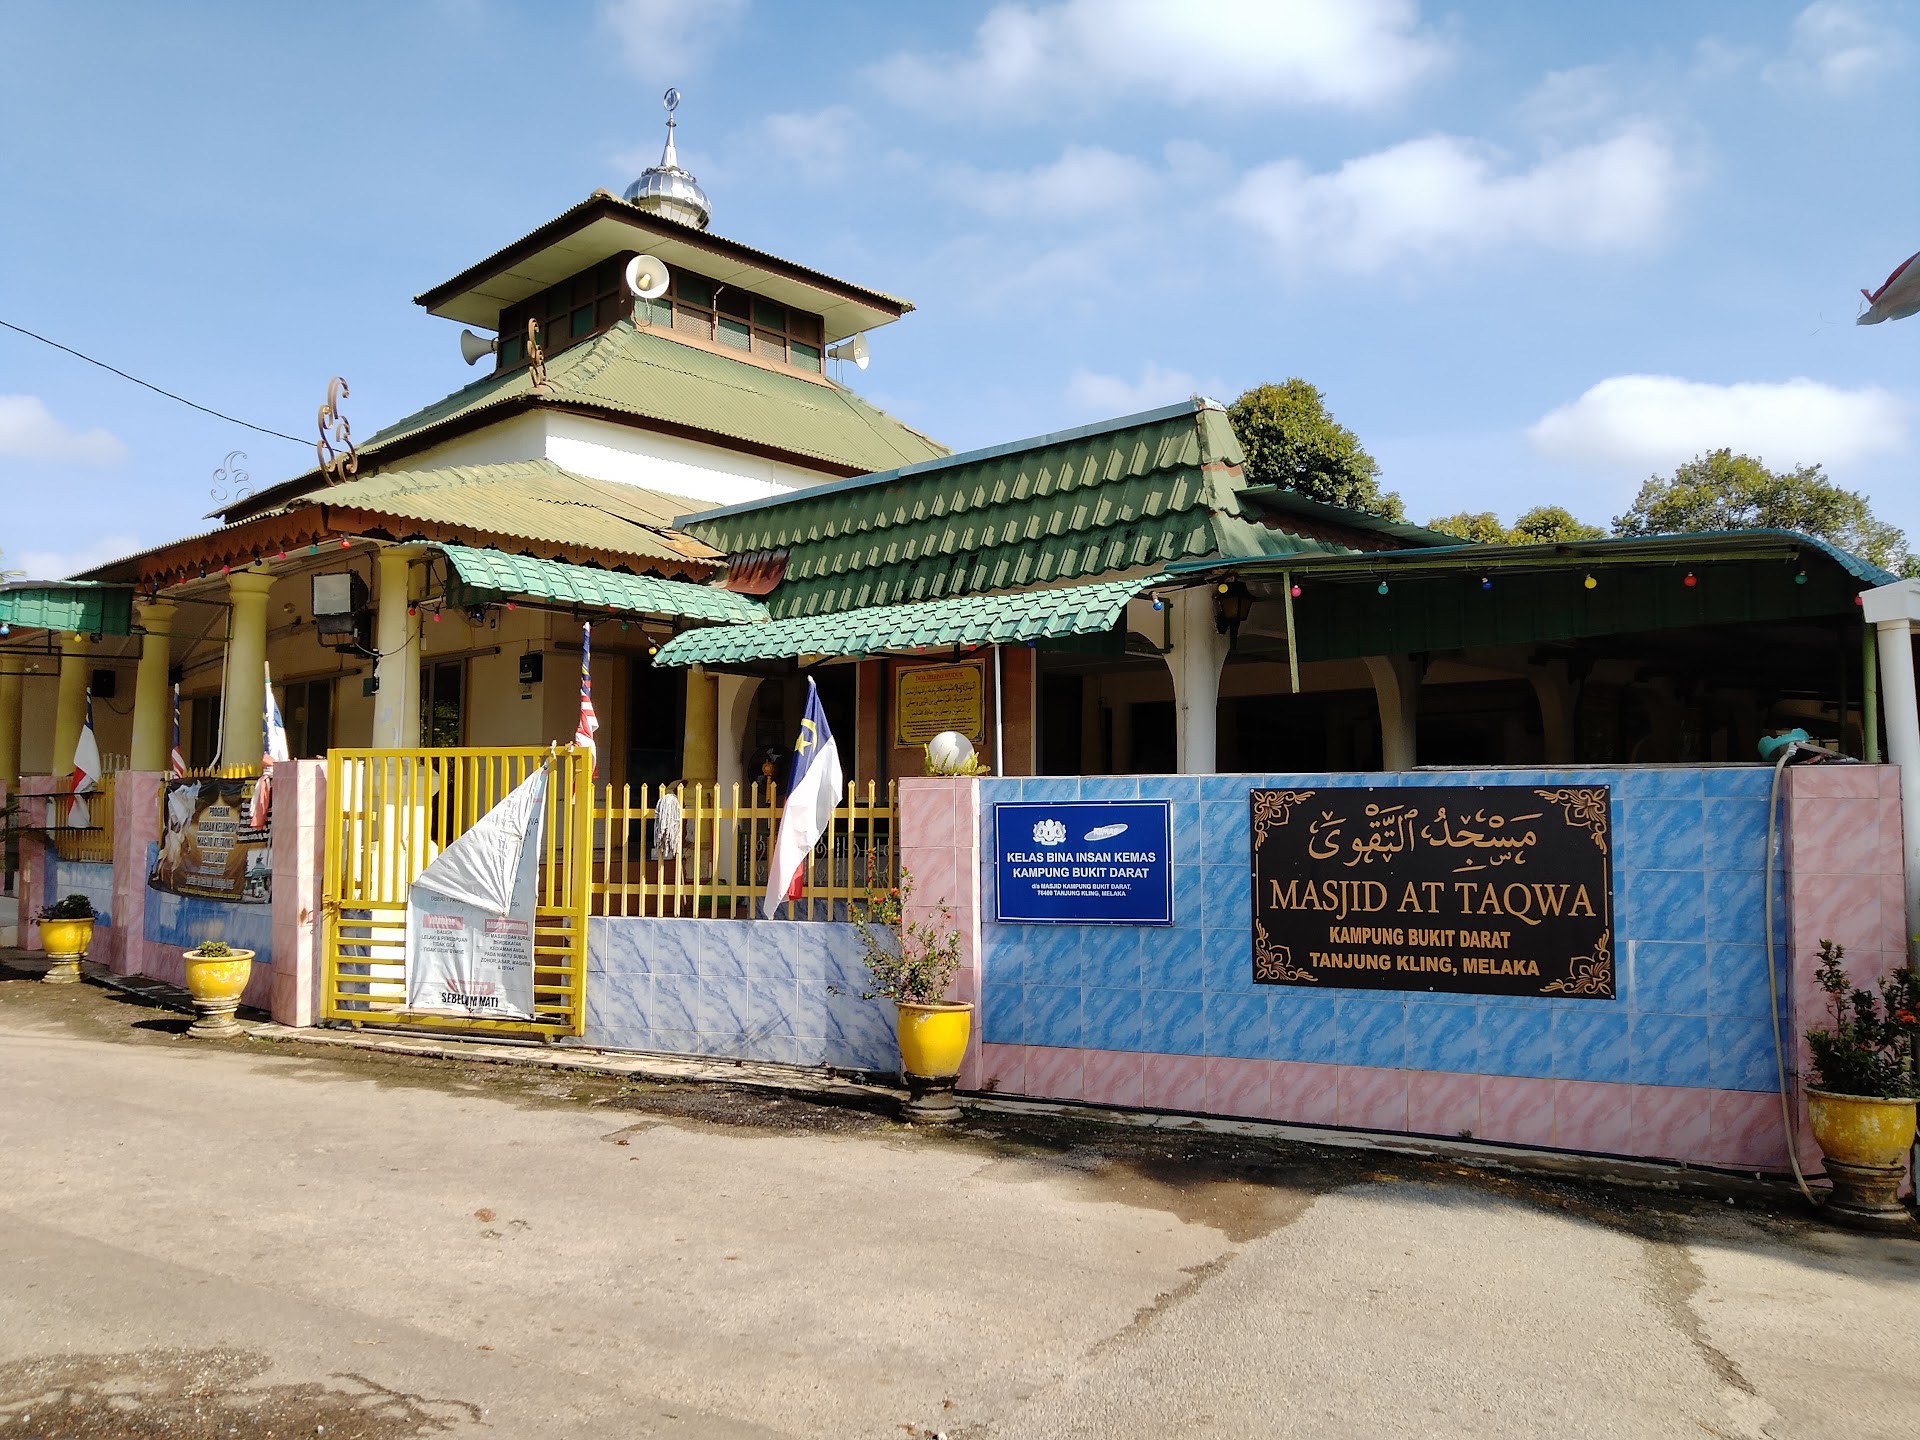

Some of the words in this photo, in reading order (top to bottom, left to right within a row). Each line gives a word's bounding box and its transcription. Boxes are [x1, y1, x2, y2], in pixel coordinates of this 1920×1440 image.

[1007, 852, 1044, 863] KELAS
[1046, 852, 1074, 863] BINA
[1076, 852, 1112, 863] INSAN
[1114, 852, 1156, 863] KEMAS
[1013, 867, 1070, 878] KAMPUNG
[1072, 867, 1107, 878] BUKIT
[1109, 867, 1150, 878] DARAT
[1270, 879, 1388, 920] MASJID
[1397, 880, 1444, 914] AT
[1454, 882, 1597, 926] TAQWA
[1329, 926, 1404, 946] KAMPUNG
[1408, 928, 1455, 948] BUKIT
[1459, 930, 1511, 949] DARAT
[1309, 952, 1392, 970] TANJUNG
[1396, 955, 1458, 976] KLING,
[1463, 957, 1540, 976] MELAKA
[441, 992, 478, 1007] SEBELUM
[479, 995, 499, 1008] MATI
